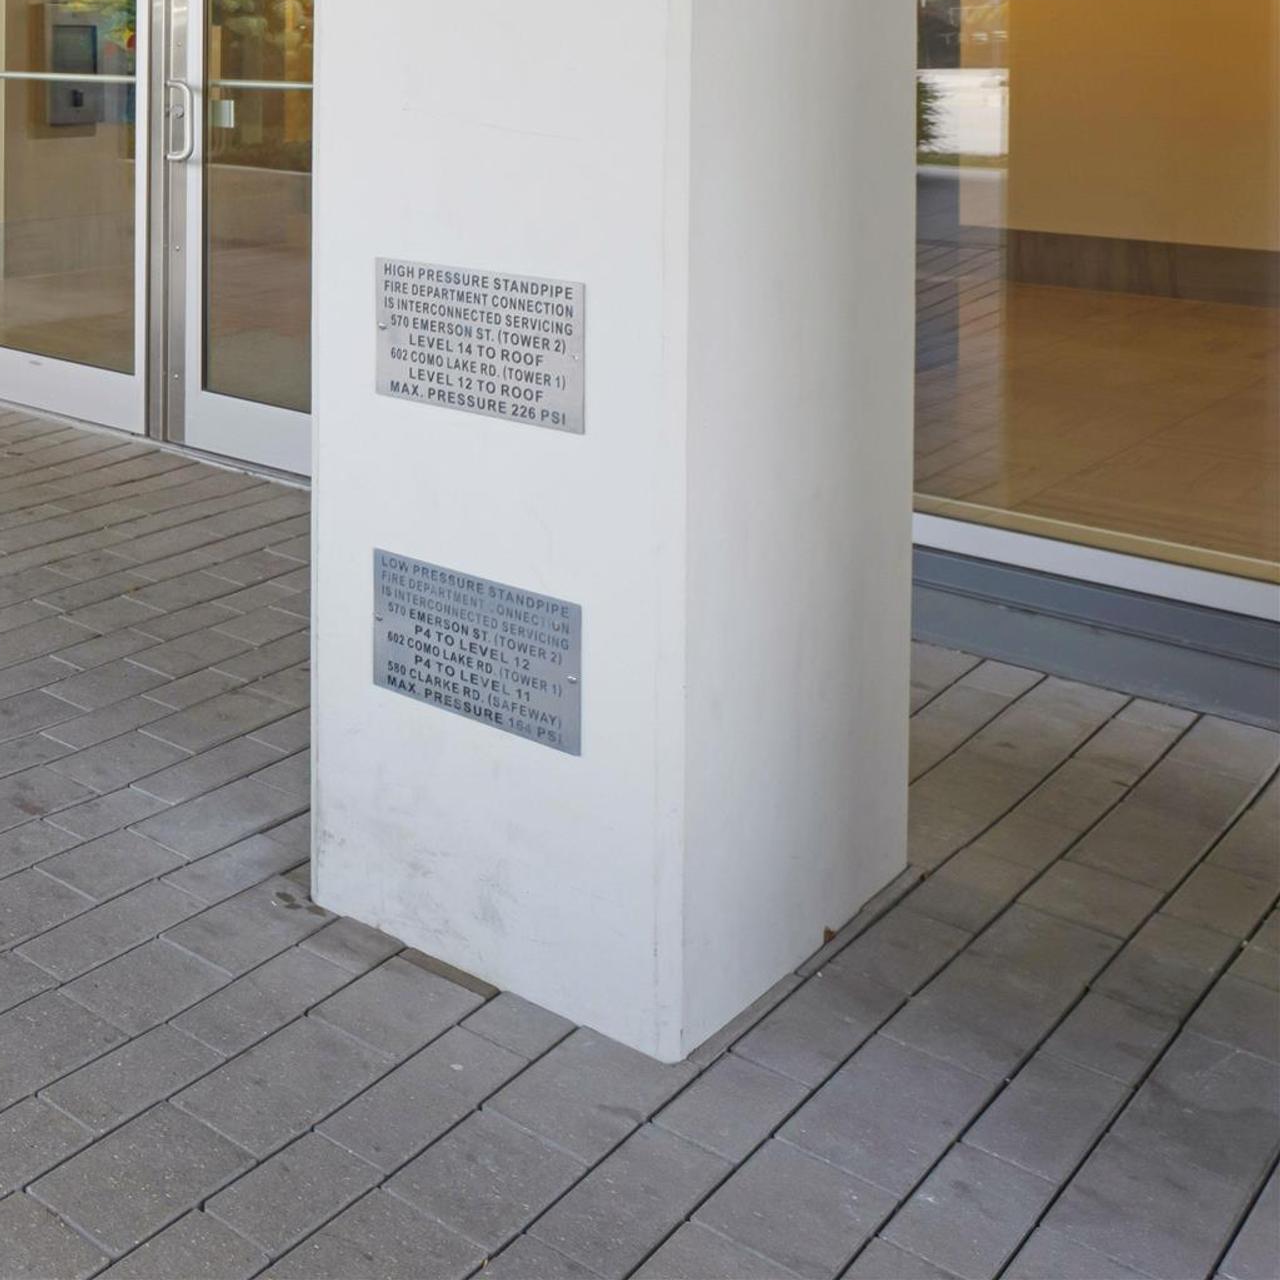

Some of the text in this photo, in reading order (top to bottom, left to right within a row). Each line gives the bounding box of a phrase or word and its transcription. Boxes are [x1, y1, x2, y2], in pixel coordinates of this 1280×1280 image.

[384, 263, 573, 300] HIGH PRESSURE STANDPIPE
[384, 280, 573, 318] FIRE DEPARTMENT CONNECTION
[384, 296, 573, 336] IS INTERCONNECTED SERVICING
[391, 314, 566, 354] 570 EMERSON ST. (TOWER 2)
[390, 347, 566, 391] 602 COMO LAKE RD. (TOWER 1)
[409, 333, 544, 367] LEVEL 14 TO ROOF
[390, 380, 566, 426] MAX. PRESSURE 226 PSI
[409, 367, 544, 403] LEVEL 12 TO ROOF
[381, 554, 569, 619] LOW PRESSURE STANDPIPE
[381, 570, 406, 587] FIRE
[408, 578, 484, 609] DEPARTMENT
[382, 585, 569, 650] IS INTERCONNECTED SERVICING
[388, 601, 406, 616] 570
[409, 608, 469, 636] EMERSON
[494, 632, 546, 660] (TOWER
[550, 651, 562, 665] 2)
[387, 630, 405, 646] 602
[407, 637, 440, 658] COMO
[442, 649, 474, 669] LAKE
[500, 667, 548, 693] (TOWER
[552, 684, 562, 698] 1)
[414, 624, 530, 671] P4 TO LEVEL 12
[387, 660, 563, 729] 580 CLARKE RD. (SAFEWAY)
[414, 654, 531, 702] P4 TO LEVEL 11
[424, 688, 504, 726] PRESSURE
[537, 726, 562, 745] PSI
